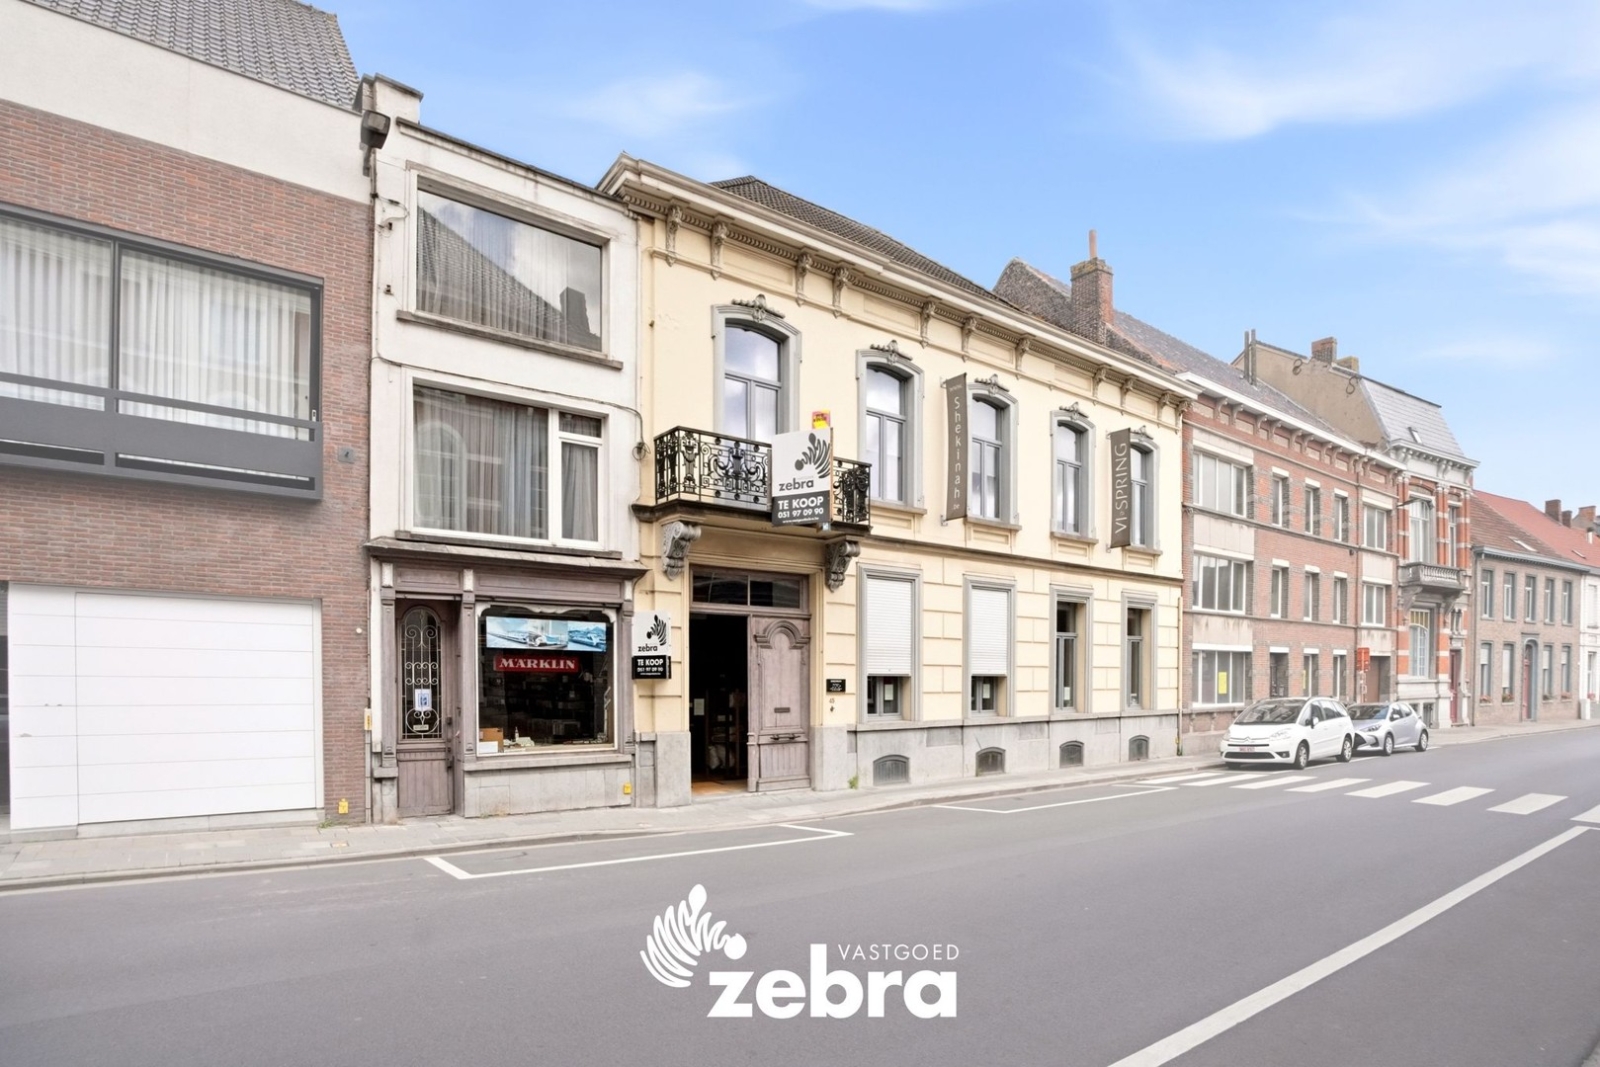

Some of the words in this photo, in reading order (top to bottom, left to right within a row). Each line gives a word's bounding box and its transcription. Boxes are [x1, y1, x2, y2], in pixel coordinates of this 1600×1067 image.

[778, 478, 814, 491] zebra
[777, 500, 789, 510] TE
[792, 496, 824, 508] KOOP
[777, 511, 790, 519] 051
[792, 509, 802, 517] 97
[803, 508, 813, 516] 09
[814, 507, 824, 515] 90
[638, 644, 658, 652] zebra
[645, 658, 664, 666] KOOP
